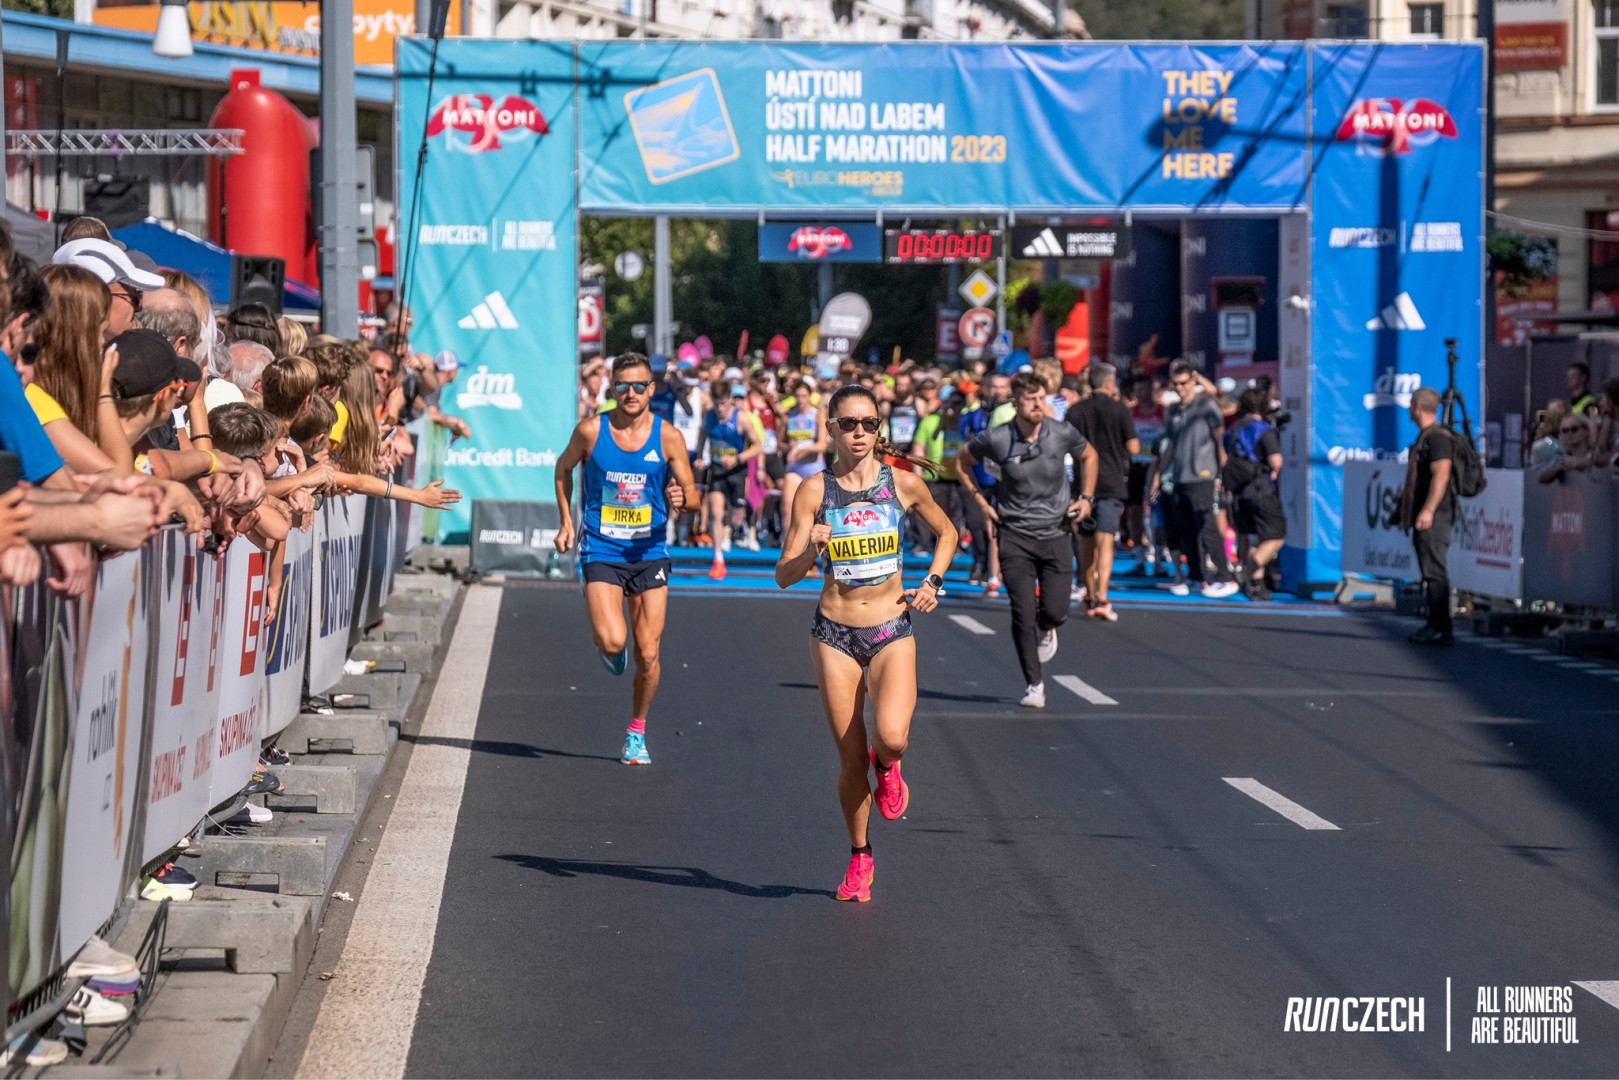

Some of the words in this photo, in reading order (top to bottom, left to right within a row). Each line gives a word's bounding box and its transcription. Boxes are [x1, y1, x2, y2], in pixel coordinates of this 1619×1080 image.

[766, 70, 862, 98] MATTONI
[1162, 71, 1235, 96] THEY
[442, 110, 535, 125] MATTONI
[766, 97, 816, 130] ÚSTÍ
[820, 103, 866, 130] NAD
[871, 103, 945, 130] LABEM
[1163, 98, 1238, 123] LOVE
[1353, 113, 1445, 129] MATTONI
[766, 135, 822, 162] HALF
[826, 135, 947, 162] MARATHON
[951, 136, 1007, 162] 2023
[1164, 127, 1204, 150] ME
[1163, 153, 1234, 179] HERE
[467, 366, 515, 394] dm
[1374, 366, 1421, 393] dm
[606, 471, 647, 484] RUNCZECH
[613, 510, 642, 523] JIRKA
[832, 536, 894, 558] VALERIIA
